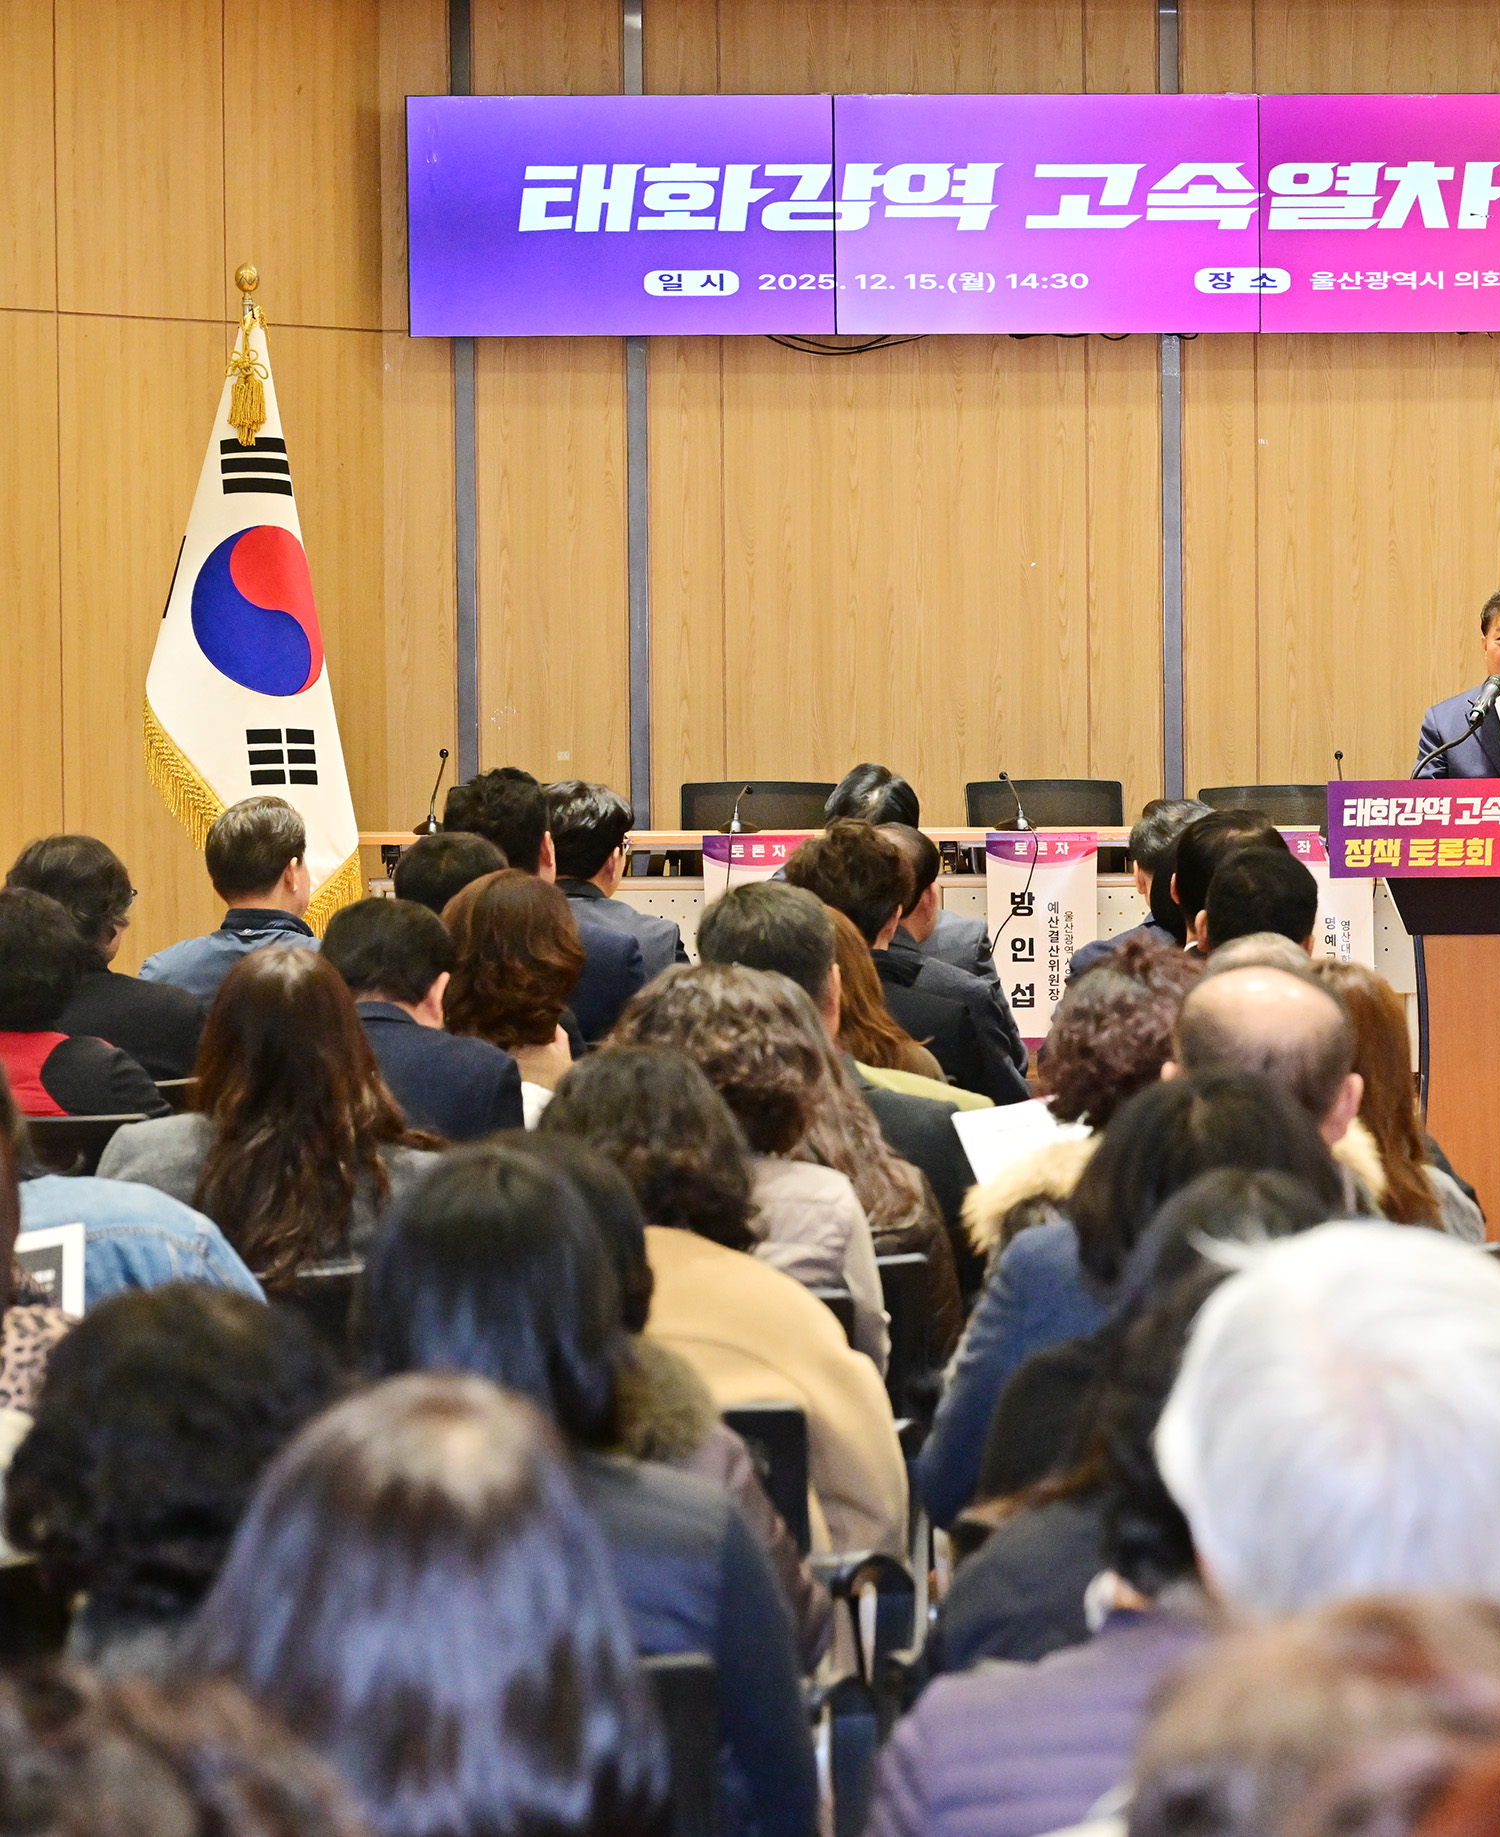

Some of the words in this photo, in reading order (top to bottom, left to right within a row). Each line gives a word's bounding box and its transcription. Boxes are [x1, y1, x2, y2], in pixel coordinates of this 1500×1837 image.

[518, 163, 1004, 232] 태화강역
[854, 273, 895, 290] 12.
[1005, 273, 1089, 290] 14:30
[1309, 271, 1444, 290] 울산광역시
[1342, 797, 1452, 827] 태화강역
[1344, 838, 1402, 867] 정책
[1408, 837, 1495, 867] 토론회
[1047, 901, 1060, 1001] 예산결산위원장
